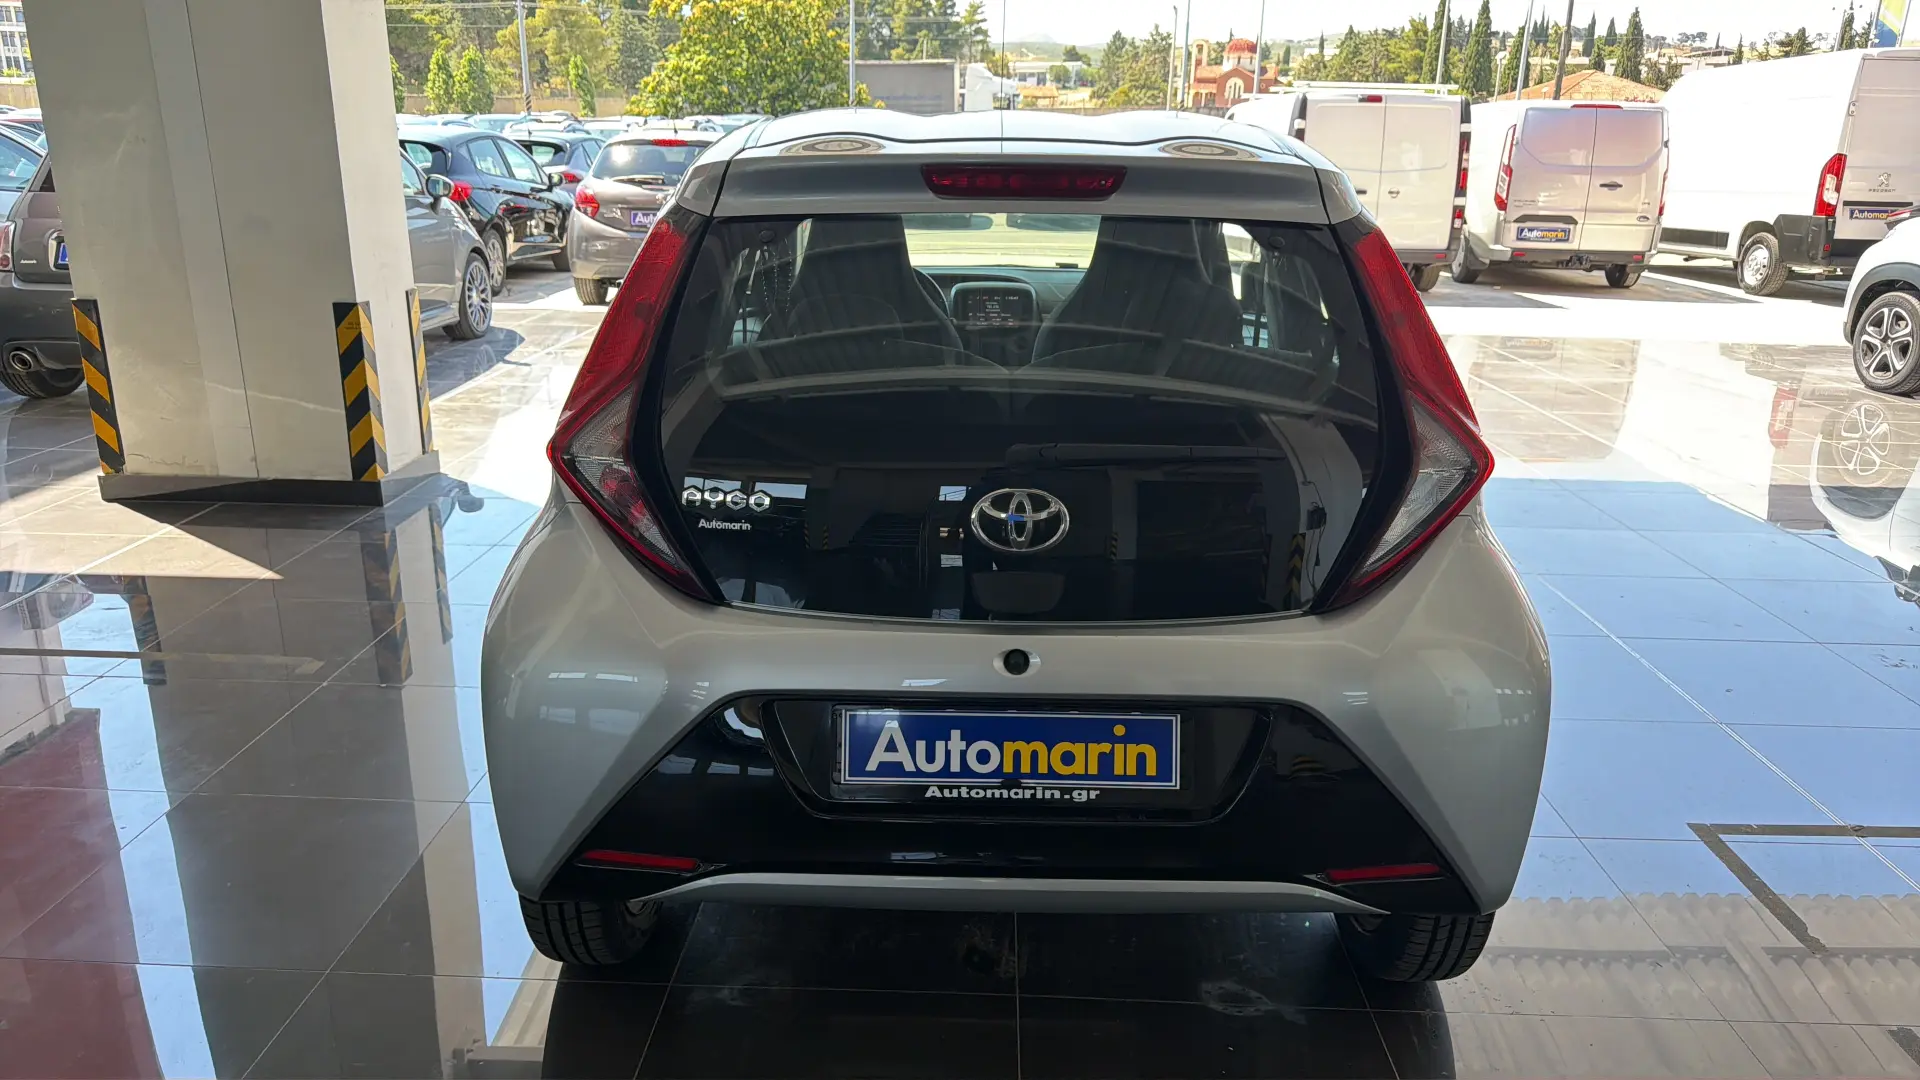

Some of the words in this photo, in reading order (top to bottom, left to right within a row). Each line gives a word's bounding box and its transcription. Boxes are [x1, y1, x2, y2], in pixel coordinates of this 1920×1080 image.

[1852, 209, 1890, 220] Automar
[1521, 228, 1565, 238] Automarin
[682, 486, 771, 512] AYGO
[698, 518, 752, 531] Automarin
[865, 719, 1157, 777] Automarin
[924, 785, 1101, 802] Automarin.gr
